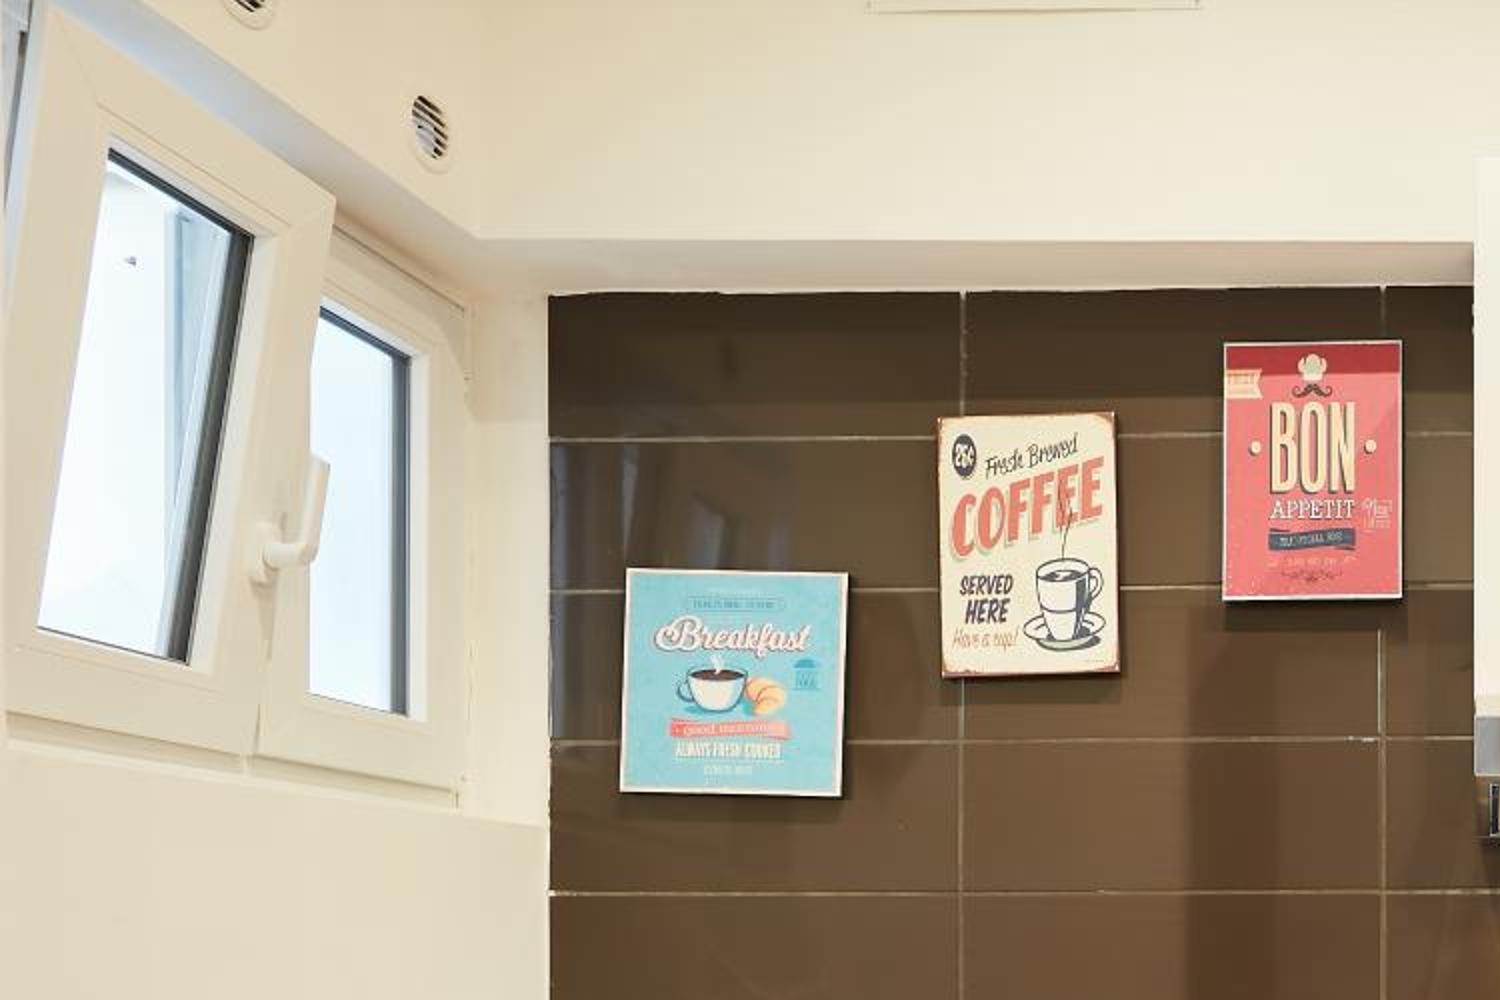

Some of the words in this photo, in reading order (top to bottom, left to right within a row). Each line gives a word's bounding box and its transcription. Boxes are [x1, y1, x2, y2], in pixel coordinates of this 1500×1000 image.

[985, 448, 1024, 479] Fresh
[1269, 402, 1356, 494] BON
[951, 456, 1105, 559] COFFEE
[1269, 499, 1354, 520] APPETIT
[960, 574, 1013, 595] SERVED
[965, 598, 1011, 624] HERE
[654, 615, 812, 660] Breakfast
